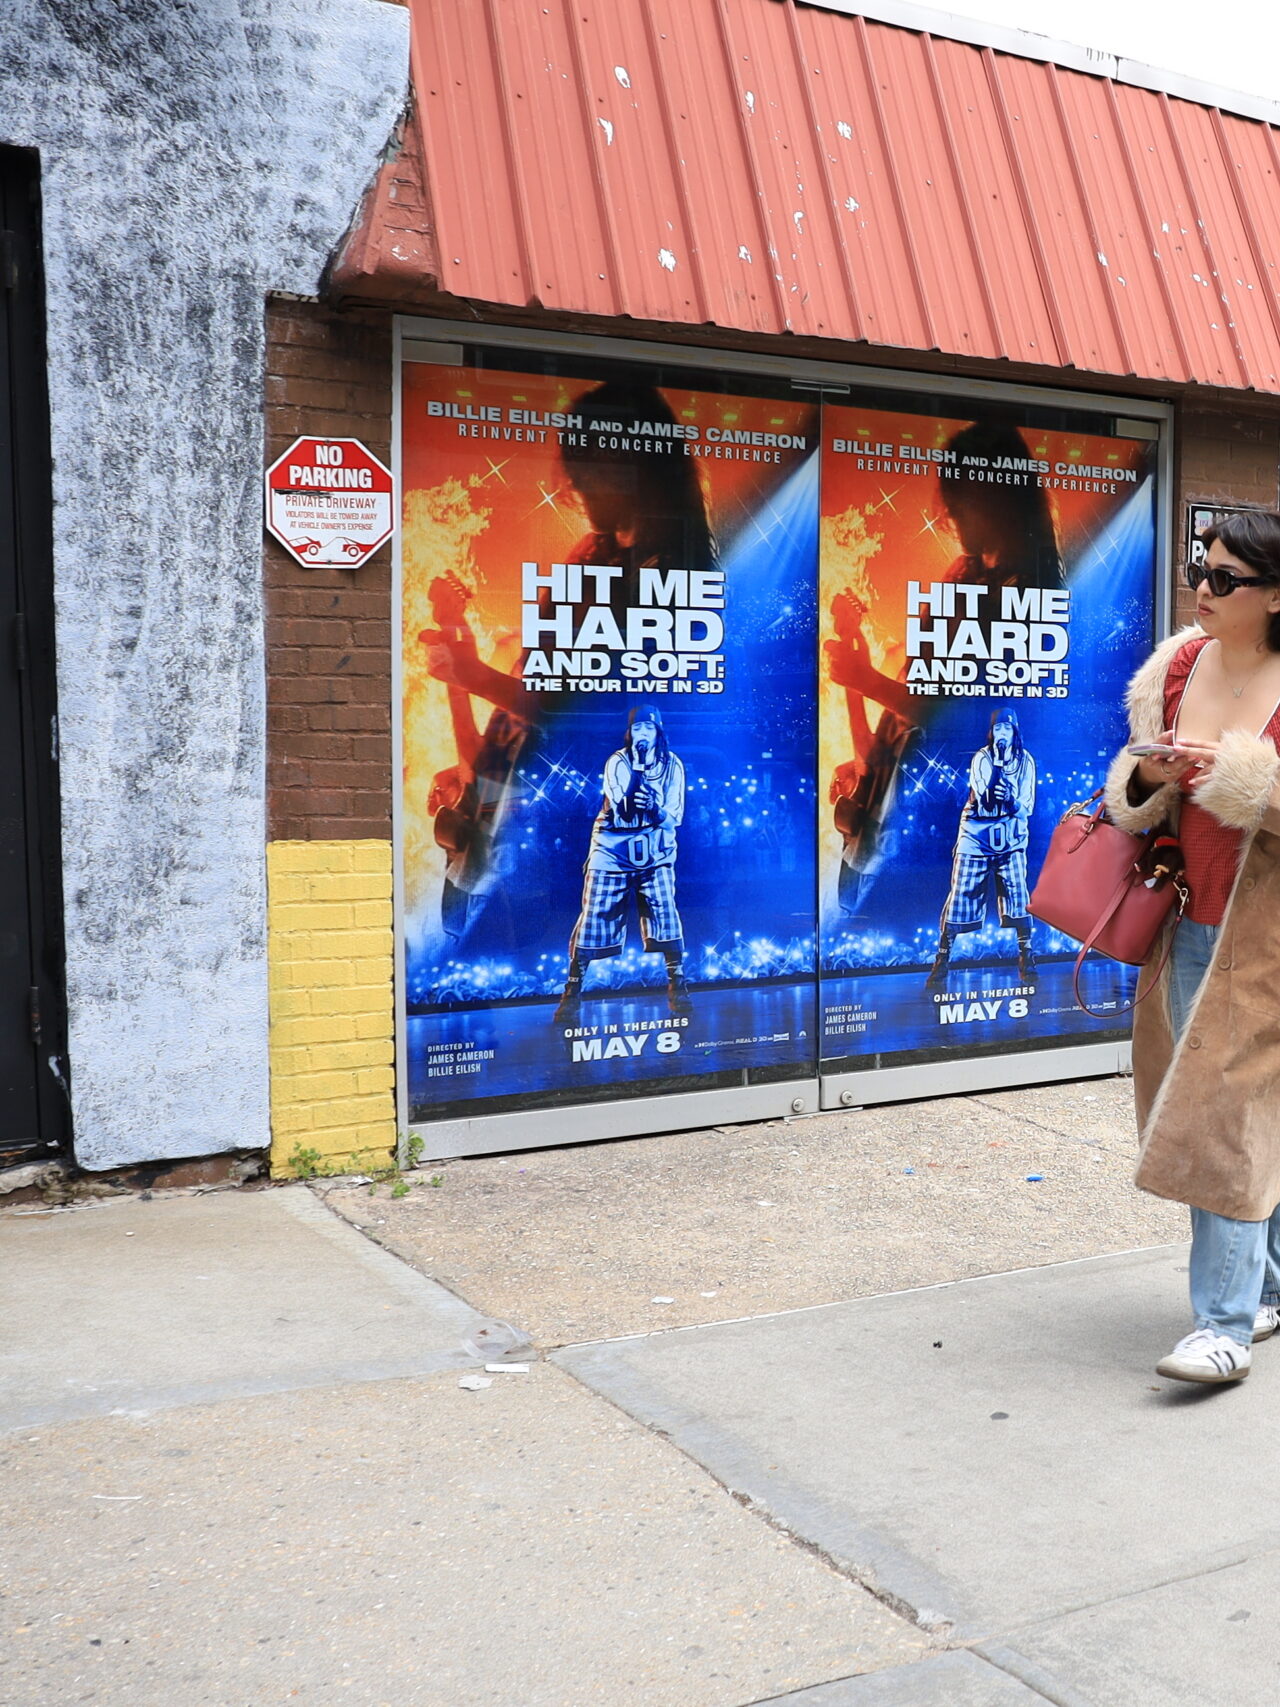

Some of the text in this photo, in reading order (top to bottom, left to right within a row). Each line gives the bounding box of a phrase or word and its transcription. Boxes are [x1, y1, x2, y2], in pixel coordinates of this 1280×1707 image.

[427, 400, 806, 450] BILLIE EILISH AND JAMES CAMERON
[458, 424, 781, 464] REINVENT THE CONCERT EXPERIENCE
[316, 445, 343, 466] NO
[833, 439, 1136, 482] BILLIE EILISH AND JAMES CAMERON
[289, 465, 372, 488] PARKING
[858, 459, 1116, 494] REINVENT THE CONCERT EXPERIENCE
[286, 496, 376, 508] PRIVATE DRIVEWAY
[286, 510, 315, 519] VIOLATORS
[316, 512, 329, 520] WILL
[330, 512, 338, 520] BE
[338, 512, 360, 520] TOWED
[298, 522, 320, 530] VEHICLE
[321, 522, 347, 530] OWNER'S
[522, 562, 725, 608] HIT ME
[907, 580, 1070, 622] HIT ME
[522, 604, 724, 652] HARD
[906, 618, 1068, 662] HARD
[522, 650, 725, 678] AND SOFT:
[906, 658, 1069, 685] AND SOFT:
[522, 678, 724, 693] THE TOUR LIVE IN 3D
[906, 684, 1068, 698] THE TOUR LIVE IN 3D
[934, 986, 1035, 1002] ONLY IN THEATRES
[825, 1006, 852, 1014] DIRECTED
[825, 1012, 876, 1024] JAMES CAMERON
[940, 1000, 1002, 1024] MAY
[1008, 998, 1028, 1018] 8
[564, 1018, 688, 1038] ONLY IN THEATRES
[825, 1024, 866, 1035] BILLIE EILISH
[428, 1043, 462, 1052] DIRECTED
[428, 1050, 494, 1064] JAMES CAMERON
[572, 1032, 680, 1062] MAY 8
[428, 1063, 480, 1077] BILLIE EILISH
